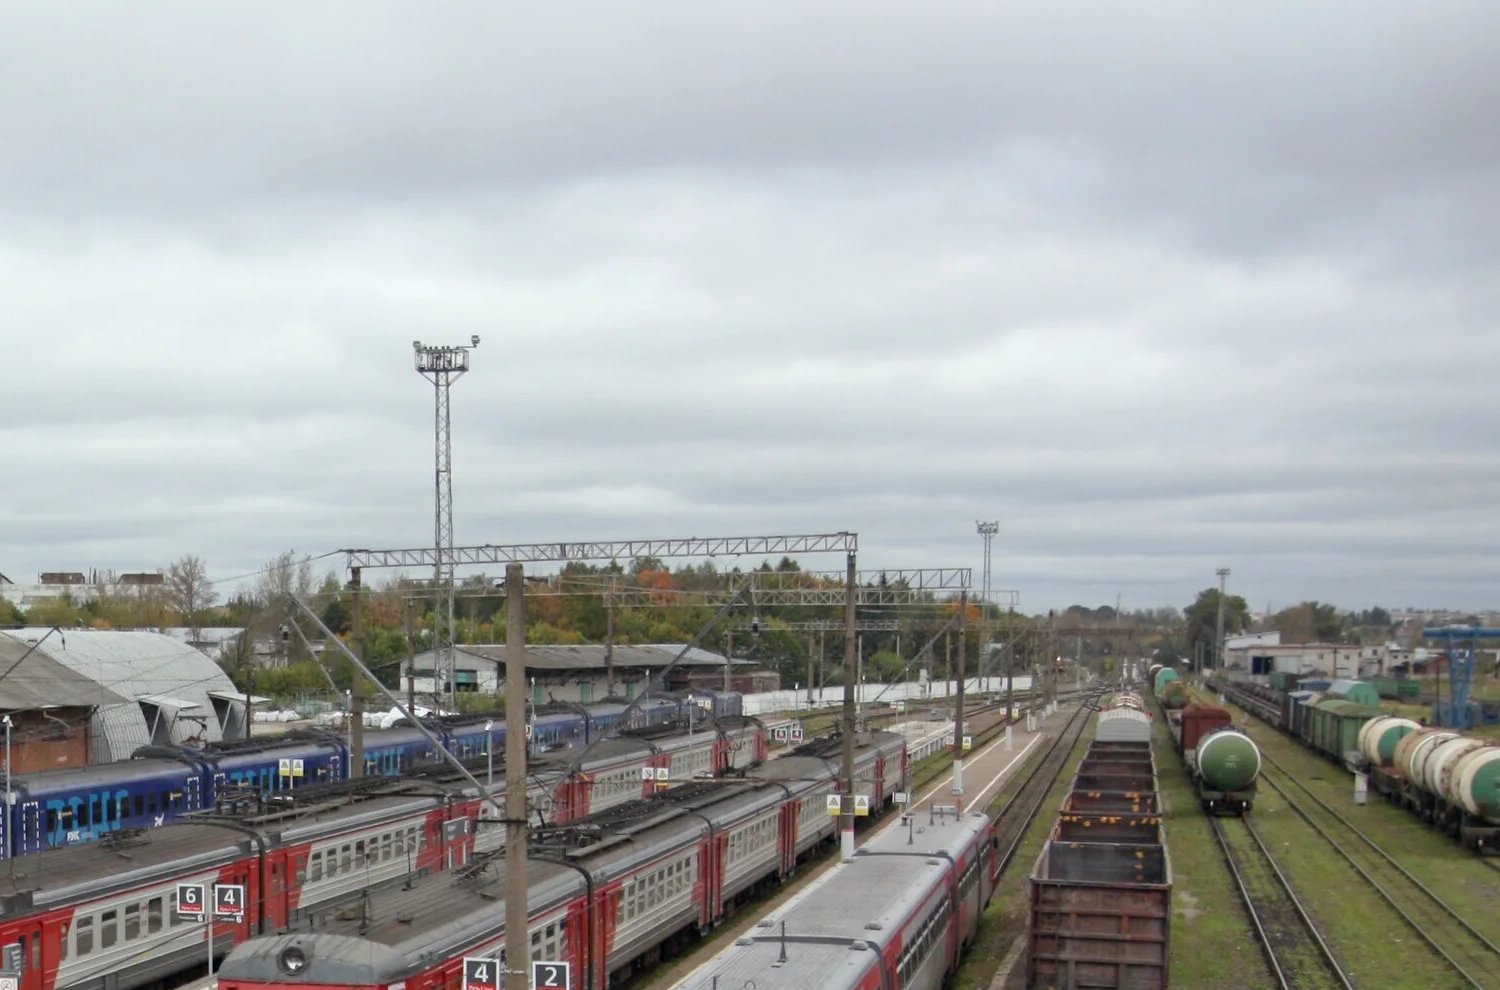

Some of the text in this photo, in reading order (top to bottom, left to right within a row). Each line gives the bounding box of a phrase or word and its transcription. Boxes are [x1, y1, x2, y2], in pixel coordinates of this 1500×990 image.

[186, 888, 196, 903] 6
[223, 889, 235, 905] 4
[474, 963, 488, 982] 4
[545, 966, 557, 987] 2
